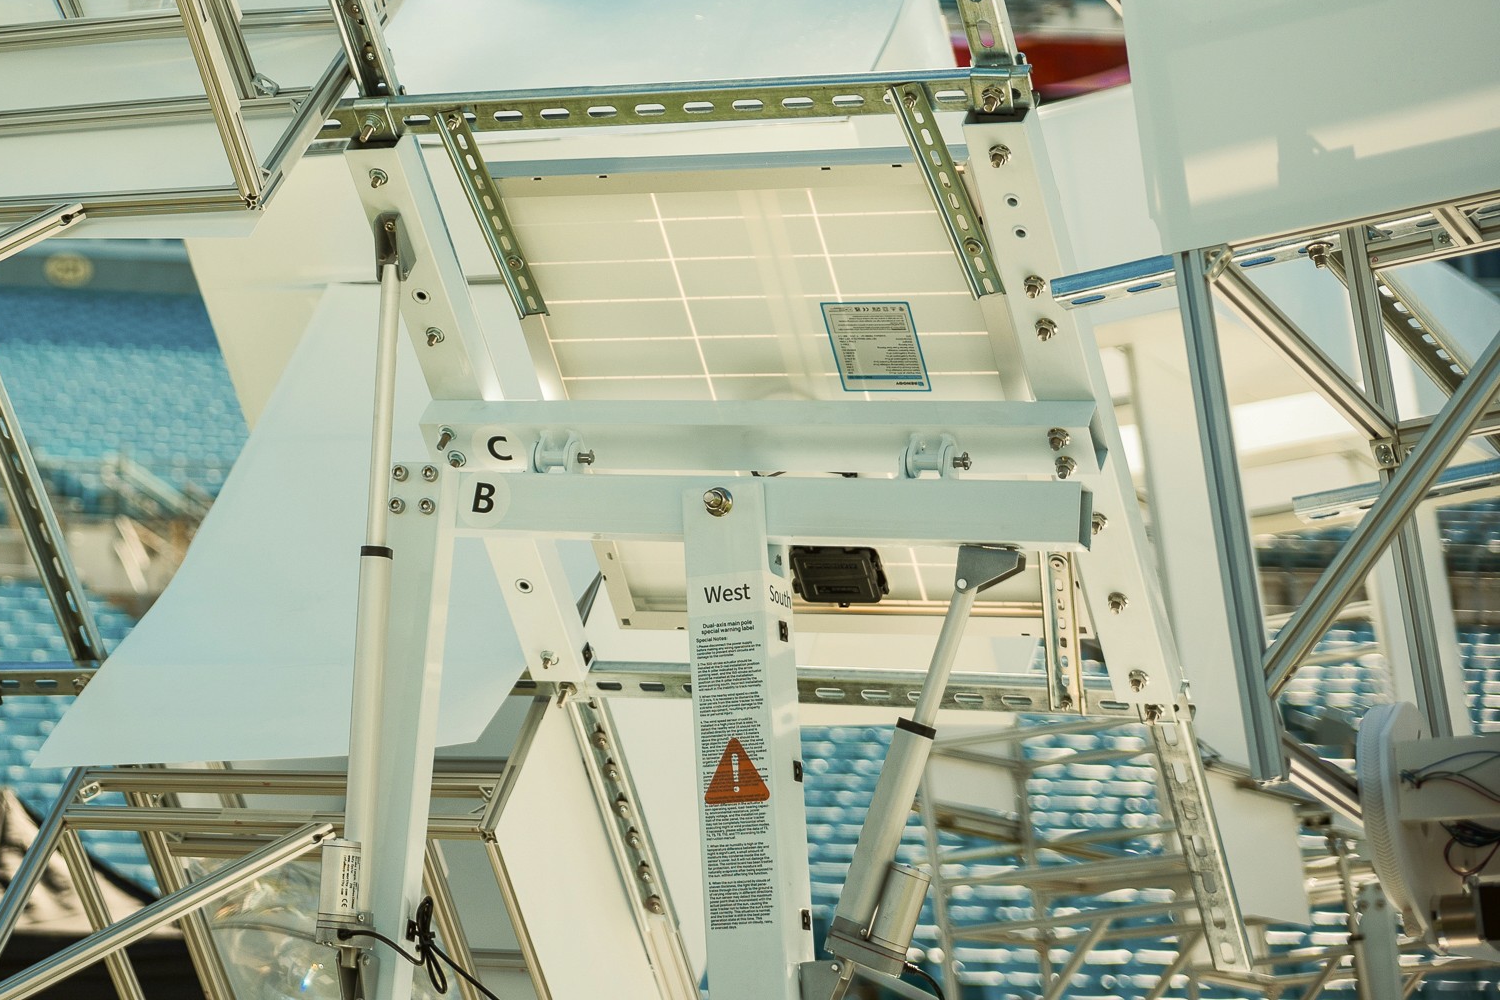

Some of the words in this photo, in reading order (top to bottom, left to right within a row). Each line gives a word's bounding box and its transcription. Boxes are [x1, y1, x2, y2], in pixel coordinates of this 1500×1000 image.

[487, 435, 513, 461] C
[472, 481, 496, 513] B
[704, 583, 751, 604] West
[769, 584, 792, 610] South
